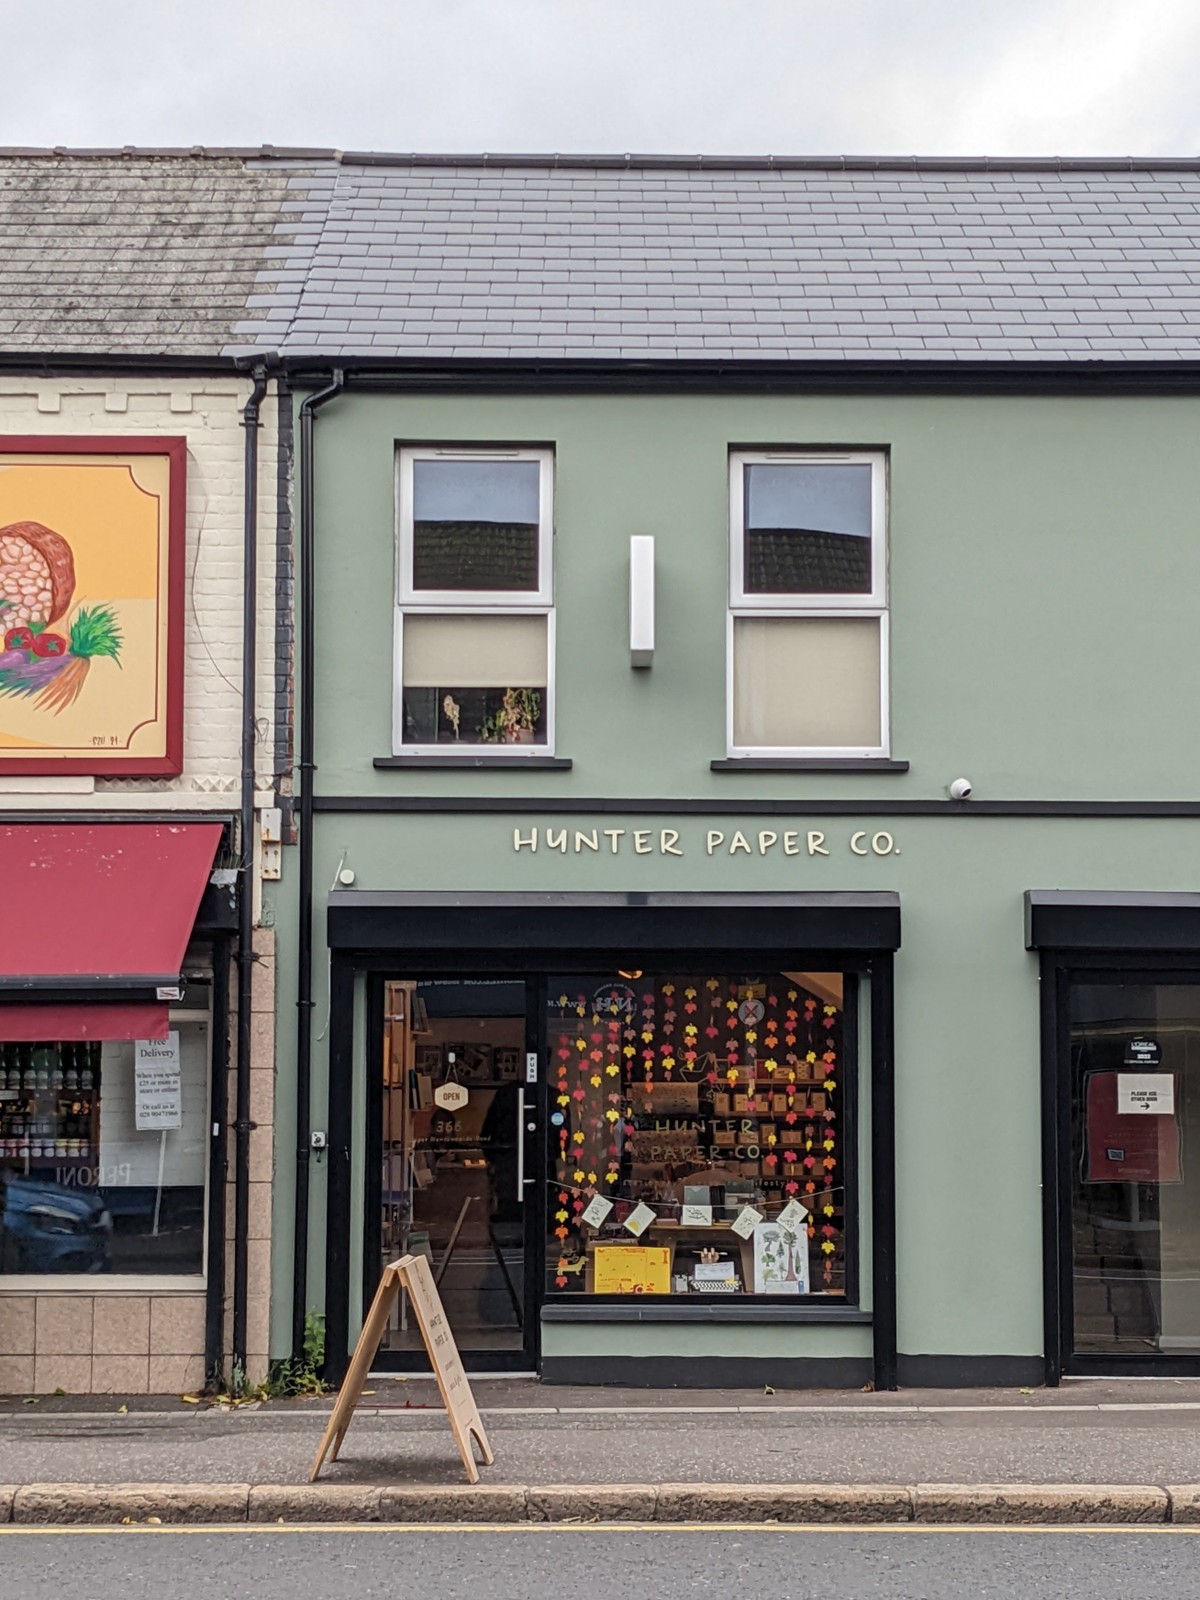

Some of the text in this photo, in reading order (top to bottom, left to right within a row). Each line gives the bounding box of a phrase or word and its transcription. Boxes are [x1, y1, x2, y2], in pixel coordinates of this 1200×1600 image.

[513, 827, 902, 856] HUNTER PAPER CO.
[140, 1049, 175, 1059] Delivery
[442, 1092, 461, 1101] OPEN
[436, 1121, 462, 1133] 366
[655, 1119, 755, 1135] HUNTER
[651, 1144, 765, 1160] PAPER CO.
